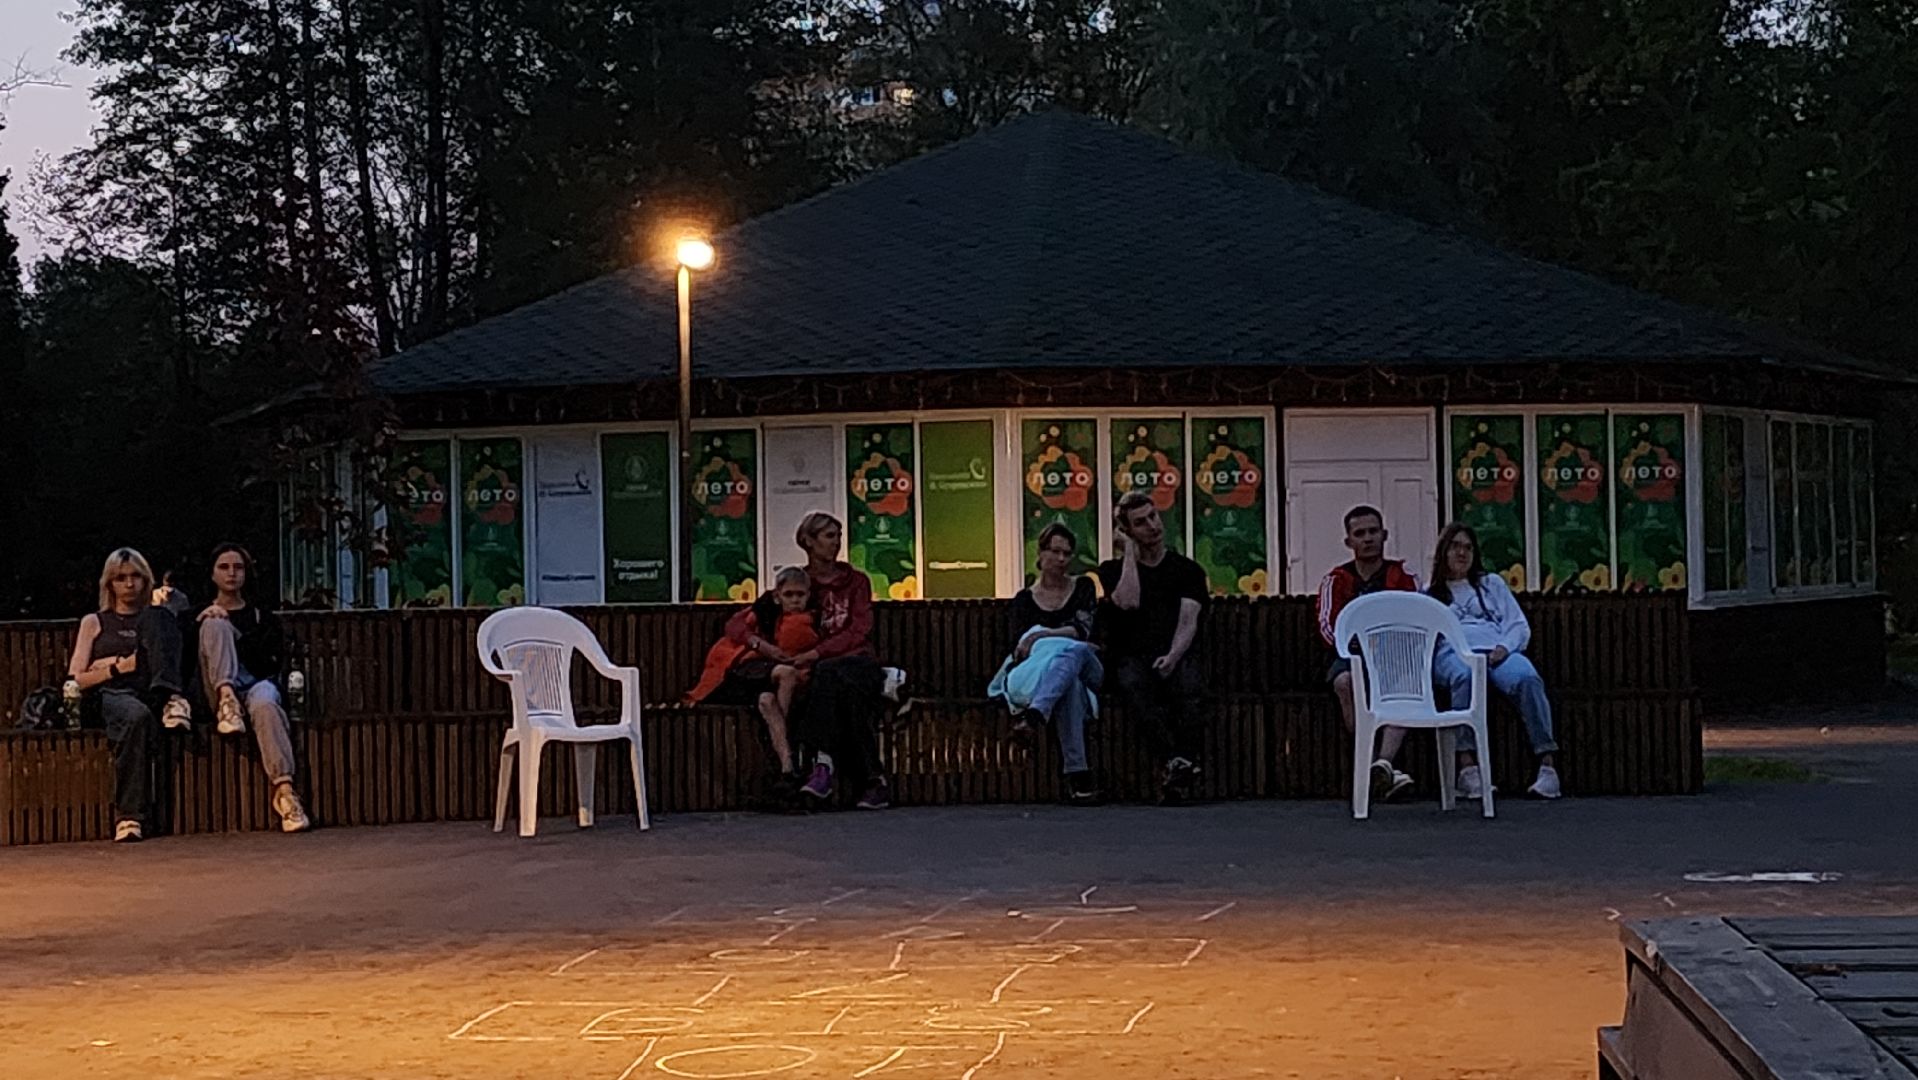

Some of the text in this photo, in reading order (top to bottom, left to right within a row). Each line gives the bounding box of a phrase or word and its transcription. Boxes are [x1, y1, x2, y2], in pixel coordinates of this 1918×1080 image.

[1032, 471, 1090, 485] лето
[1120, 471, 1177, 485] лето
[1203, 470, 1257, 484] лето
[1462, 466, 1517, 481] лето
[1549, 466, 1600, 480] лето
[1624, 465, 1677, 478] лето
[697, 481, 748, 495] лето
[856, 478, 910, 492] лето
[468, 489, 516, 501] лето
